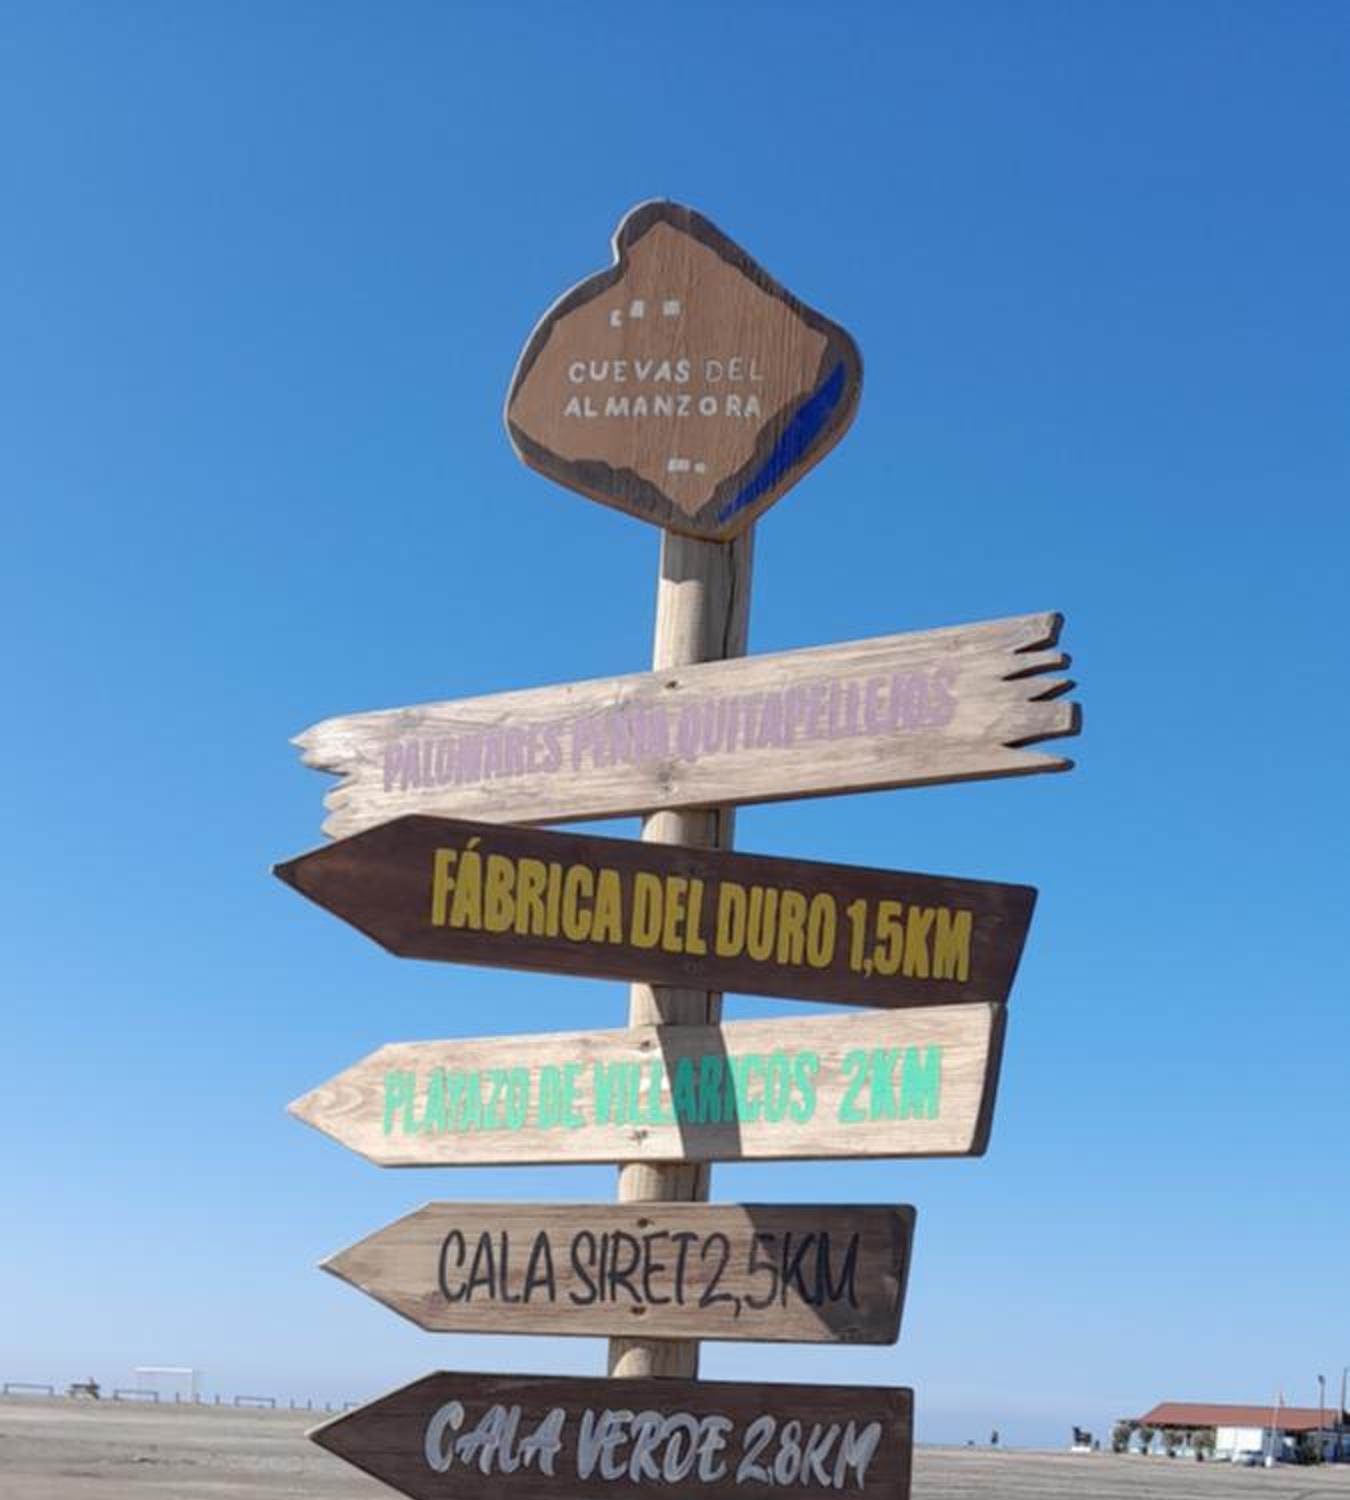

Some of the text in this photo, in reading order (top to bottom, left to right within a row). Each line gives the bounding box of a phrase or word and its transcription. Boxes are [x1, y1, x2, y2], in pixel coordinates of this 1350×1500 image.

[564, 394, 761, 418] ALMANZORA
[569, 358, 763, 383] CUEVAS DEL
[431, 837, 974, 982] FÁBRICA DEL DURO 1,5KM
[384, 1044, 945, 1136] PLAYAZO DE VILLARICOS 2KM
[438, 1229, 861, 1319] CALA SIRET 2,5KM
[424, 1401, 568, 1477] CALA
[577, 1408, 734, 1485] VERDE
